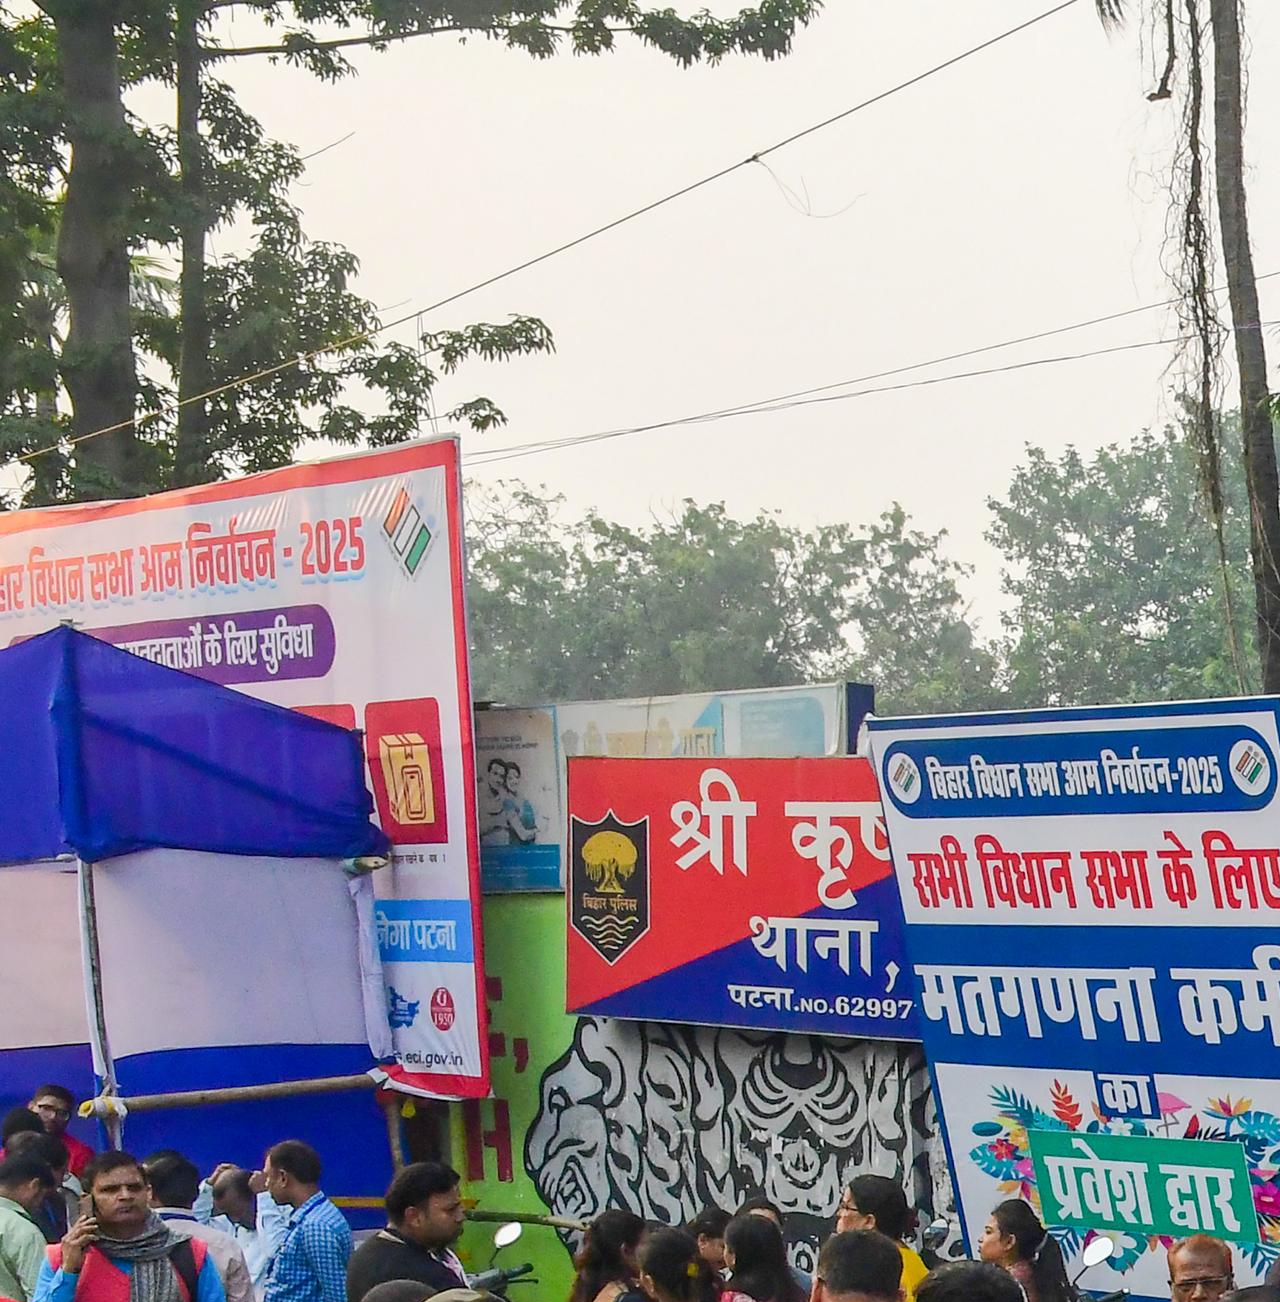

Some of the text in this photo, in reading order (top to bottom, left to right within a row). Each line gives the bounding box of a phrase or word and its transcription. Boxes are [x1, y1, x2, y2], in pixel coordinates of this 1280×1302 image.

[27, 546, 86, 608] विधान
[87, 548, 134, 602] सभा
[139, 541, 184, 593] आम
[187, 517, 277, 589] निर्वाचन
[301, 516, 366, 576] 2025
[203, 623, 222, 667] के
[224, 620, 258, 666] लिए
[260, 614, 314, 675] सुविधा
[924, 756, 973, 799] बिहार
[971, 754, 1021, 799] विधान
[1024, 760, 1059, 797] सभा
[1062, 759, 1101, 796] आम
[669, 767, 893, 910] श्री कृष
[907, 834, 973, 910] सभी
[973, 834, 1077, 910] विधान
[1081, 849, 1152, 909] सभा
[1156, 830, 1198, 909] के
[411, 919, 457, 951] पटना
[582, 892, 638, 915] बिहार पुलिस
[913, 963, 1162, 1043] मतगणना
[1098, 1073, 1151, 1116] का
[1043, 1137, 1241, 1234] प्रवेश द्वार
